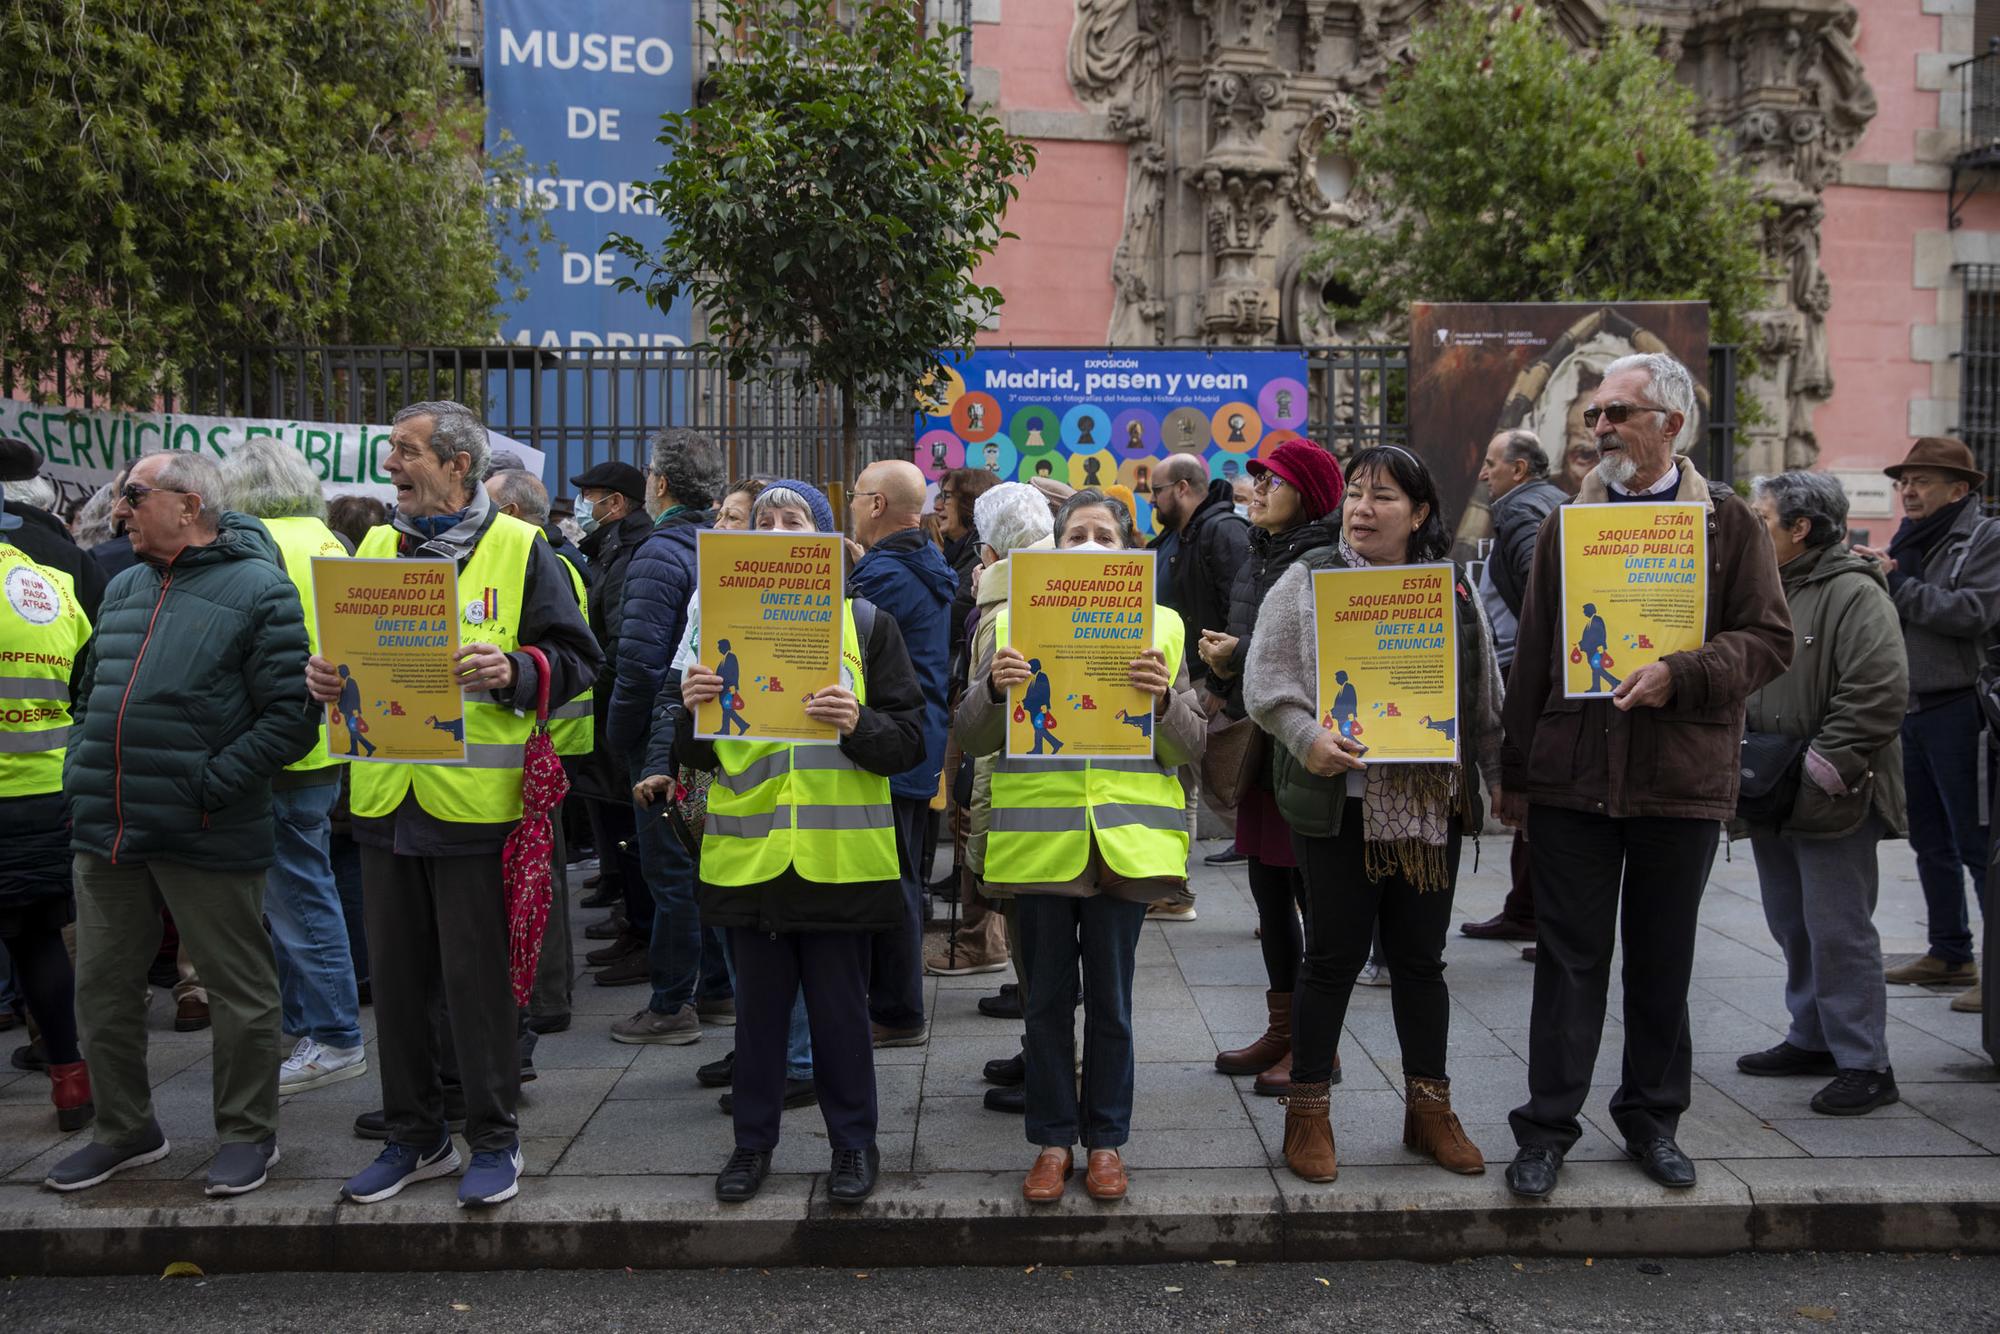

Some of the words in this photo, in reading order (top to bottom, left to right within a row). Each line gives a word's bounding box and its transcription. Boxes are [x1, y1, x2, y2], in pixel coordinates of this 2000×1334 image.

[500, 28, 673, 76] MUSEO
[567, 107, 620, 141] DE
[563, 253, 615, 286] DE
[1084, 358, 1139, 369] EXPOSICIÓN
[985, 368, 1080, 392] Madrid,
[1085, 373, 1162, 395] pasen
[1166, 373, 1182, 396] y
[1186, 373, 1248, 390] vean
[1654, 512, 1694, 525] ESTÁN
[1598, 529, 1676, 542] SAQUEANDO
[1679, 530, 1694, 540] LA
[790, 544, 831, 559] ESTÁN
[1583, 544, 1639, 556] SANIDAD
[1642, 544, 1694, 555] PUBLICA
[734, 560, 812, 575] SAQUEANDO
[816, 563, 831, 574] LA
[1103, 561, 1144, 576] ESTÁN
[1625, 555, 1666, 569] ÚNETE
[1668, 558, 1676, 569] A
[1680, 558, 1695, 569] LA
[403, 569, 444, 584] ESTÁN
[718, 576, 775, 589] SANIDAD
[778, 578, 831, 590] PUBLICA
[1402, 575, 1442, 590] ESTÁN
[1628, 572, 1696, 584] DENUNCIA!
[1045, 580, 1125, 593] SAQUEANDO
[1128, 580, 1143, 592] LA
[23, 589, 48, 600] PASO
[348, 587, 426, 601] SAQUEANDO
[430, 588, 445, 600] LA
[760, 590, 802, 606] ÚNETE
[804, 594, 813, 606] A
[816, 594, 831, 606] LA
[1348, 592, 1424, 608] SAQUEANDO
[1428, 592, 1442, 604] LA
[22, 599, 52, 611] ATRAS
[1030, 595, 1087, 607] SANIDAD
[1090, 596, 1143, 608] PUBLICA
[334, 602, 388, 616] SANIDAD
[392, 604, 446, 616] PUBLICA
[763, 608, 832, 622] DENUNCIA!
[1072, 608, 1114, 623] ÚNETE
[1115, 612, 1124, 623] A
[1128, 612, 1142, 624] LA
[1334, 609, 1389, 622] SANIDAD
[1392, 608, 1442, 620] PUBLICA
[374, 616, 416, 631] ÚNETE
[419, 620, 427, 631] A
[432, 620, 447, 632] LA
[1375, 621, 1415, 636] ÚNETE
[1417, 624, 1426, 634] A
[1429, 623, 1443, 634] LA
[1074, 627, 1144, 640] DENUNCIA!
[378, 635, 448, 648] DENUNCIA!
[1378, 637, 1445, 650] DENUNCIA!
[0, 707, 63, 723] OESPE
